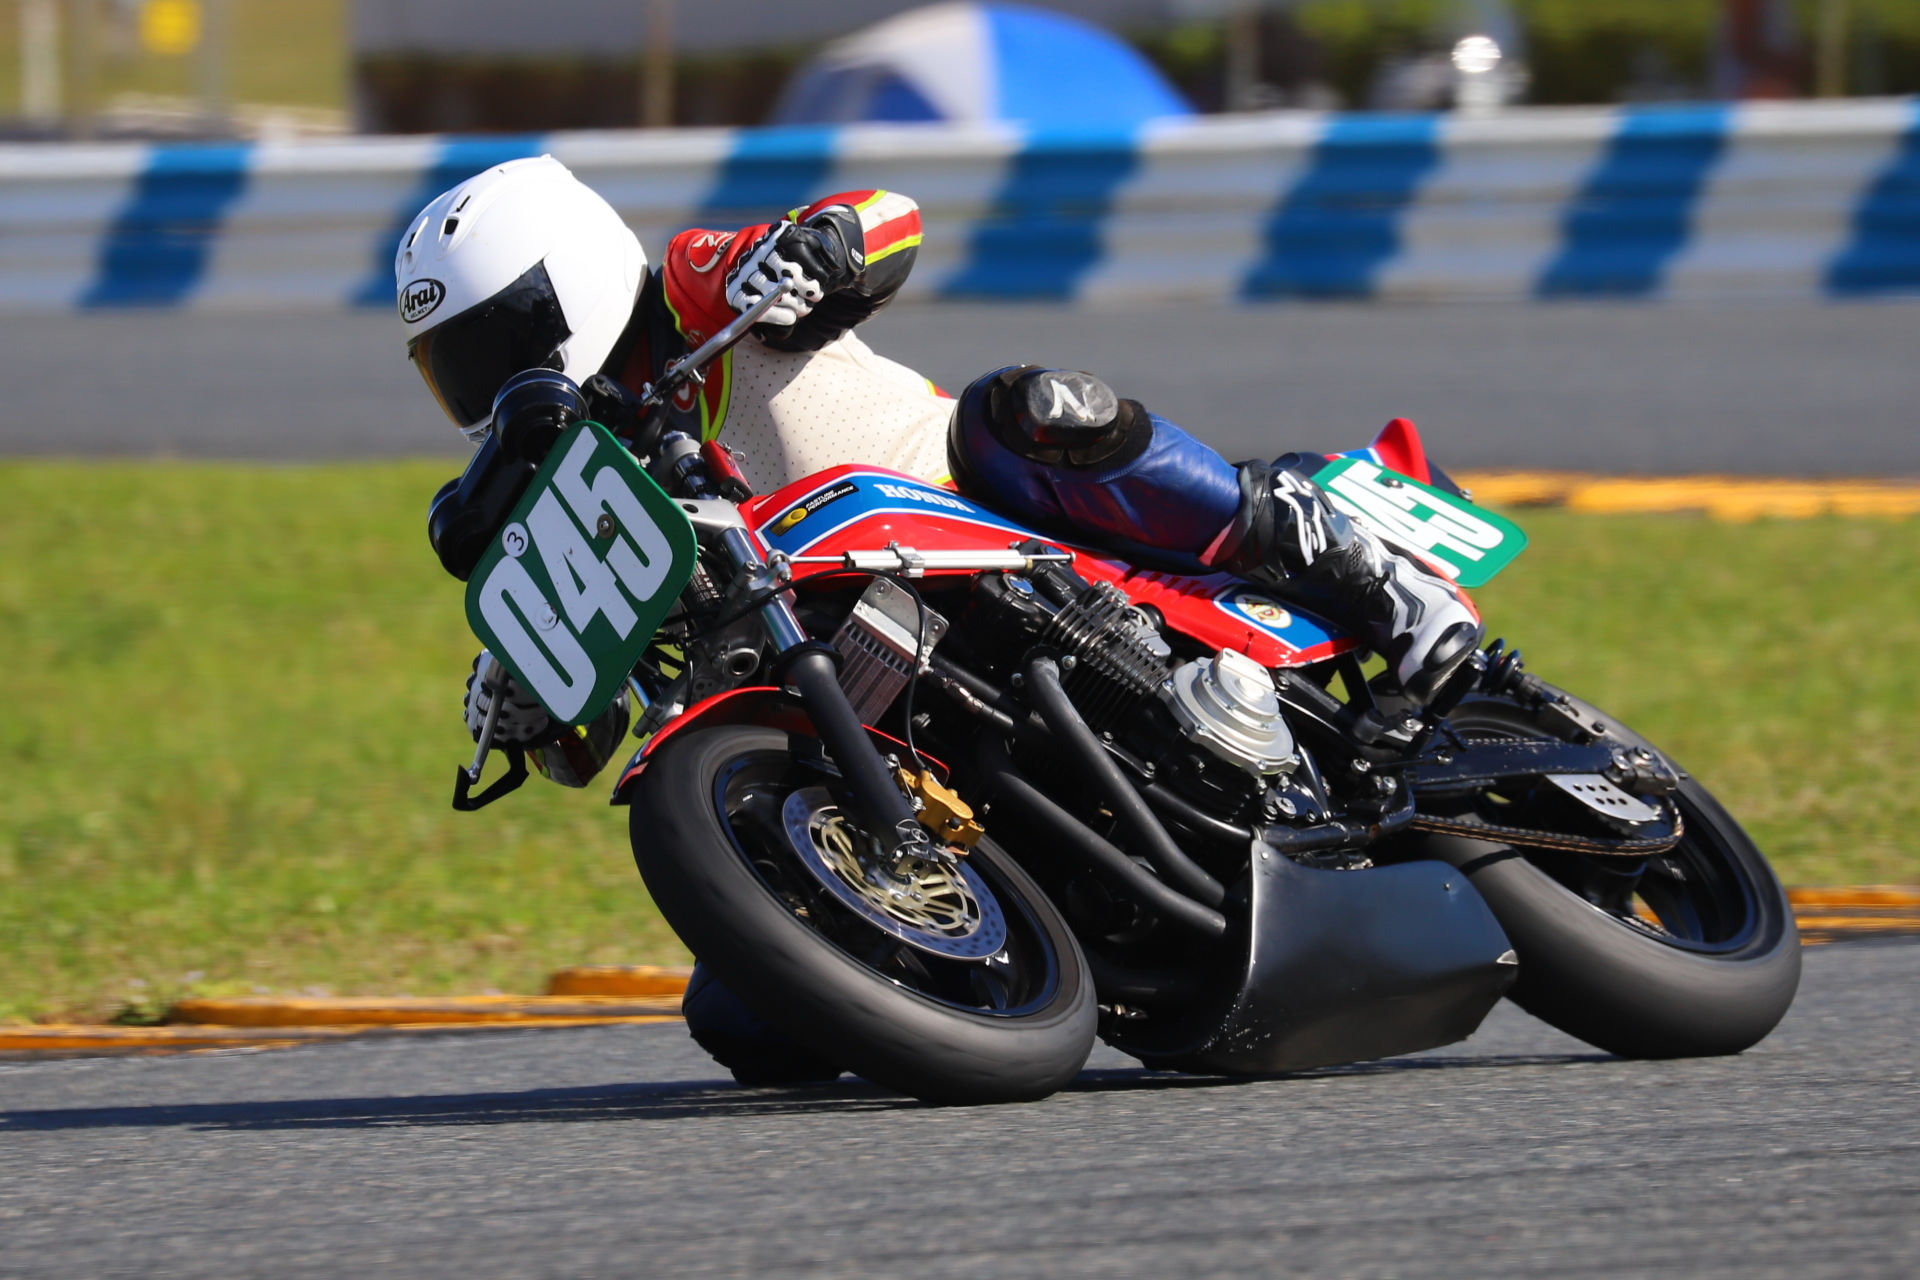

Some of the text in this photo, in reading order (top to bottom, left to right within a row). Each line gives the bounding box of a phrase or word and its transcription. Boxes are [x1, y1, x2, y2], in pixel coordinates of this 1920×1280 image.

[403, 280, 438, 314] Arai
[807, 485, 854, 512] PERFORMANCE
[874, 484, 976, 514] HONDA
[506, 531, 525, 551] 3
[479, 425, 673, 722] 045
